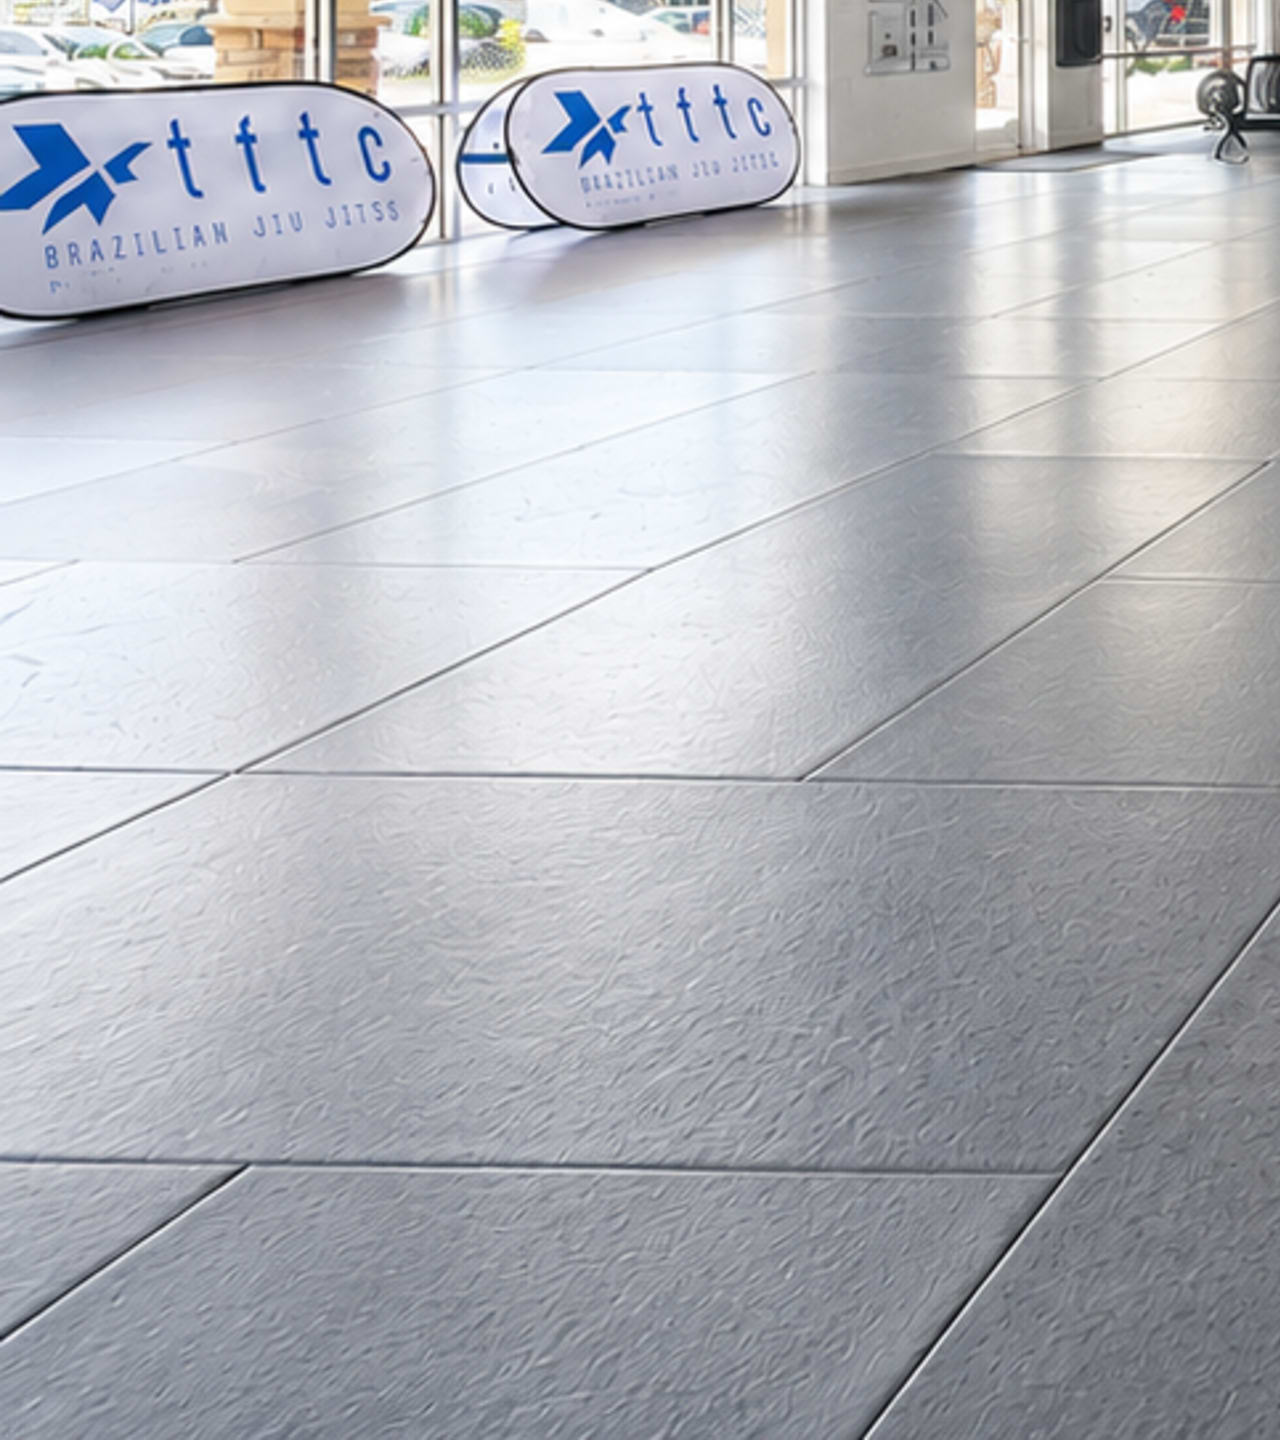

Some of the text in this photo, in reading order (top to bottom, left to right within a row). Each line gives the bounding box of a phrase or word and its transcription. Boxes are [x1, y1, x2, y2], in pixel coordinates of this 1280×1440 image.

[636, 84, 772, 147] tftc
[167, 111, 393, 199] tftc
[44, 220, 229, 270] BRAZILIAN
[253, 212, 304, 239] JIU
